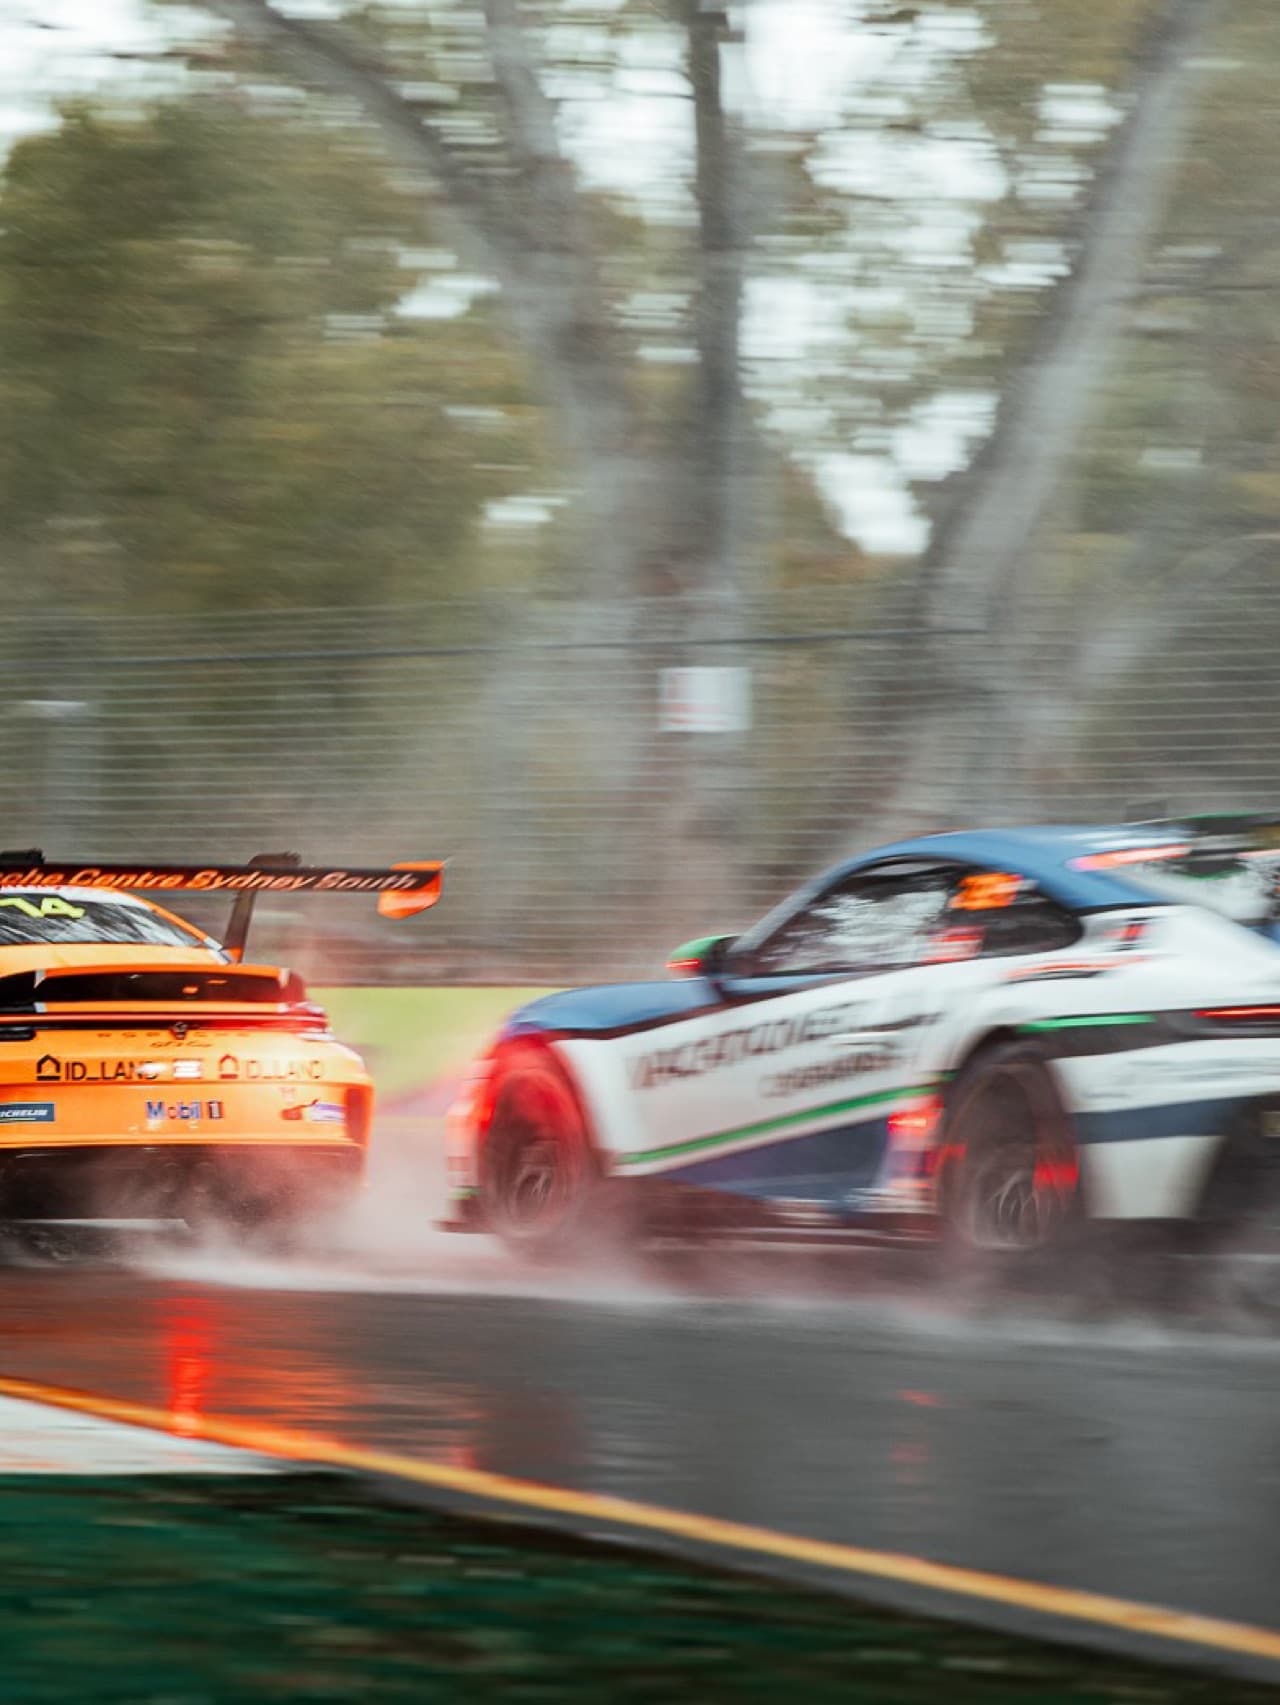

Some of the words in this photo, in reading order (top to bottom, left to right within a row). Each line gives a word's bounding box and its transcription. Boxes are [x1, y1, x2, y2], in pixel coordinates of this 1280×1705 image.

[67, 868, 184, 888] Centre
[186, 870, 317, 890] Sydney
[312, 871, 418, 890] South
[145, 1101, 202, 1120] Mobil
